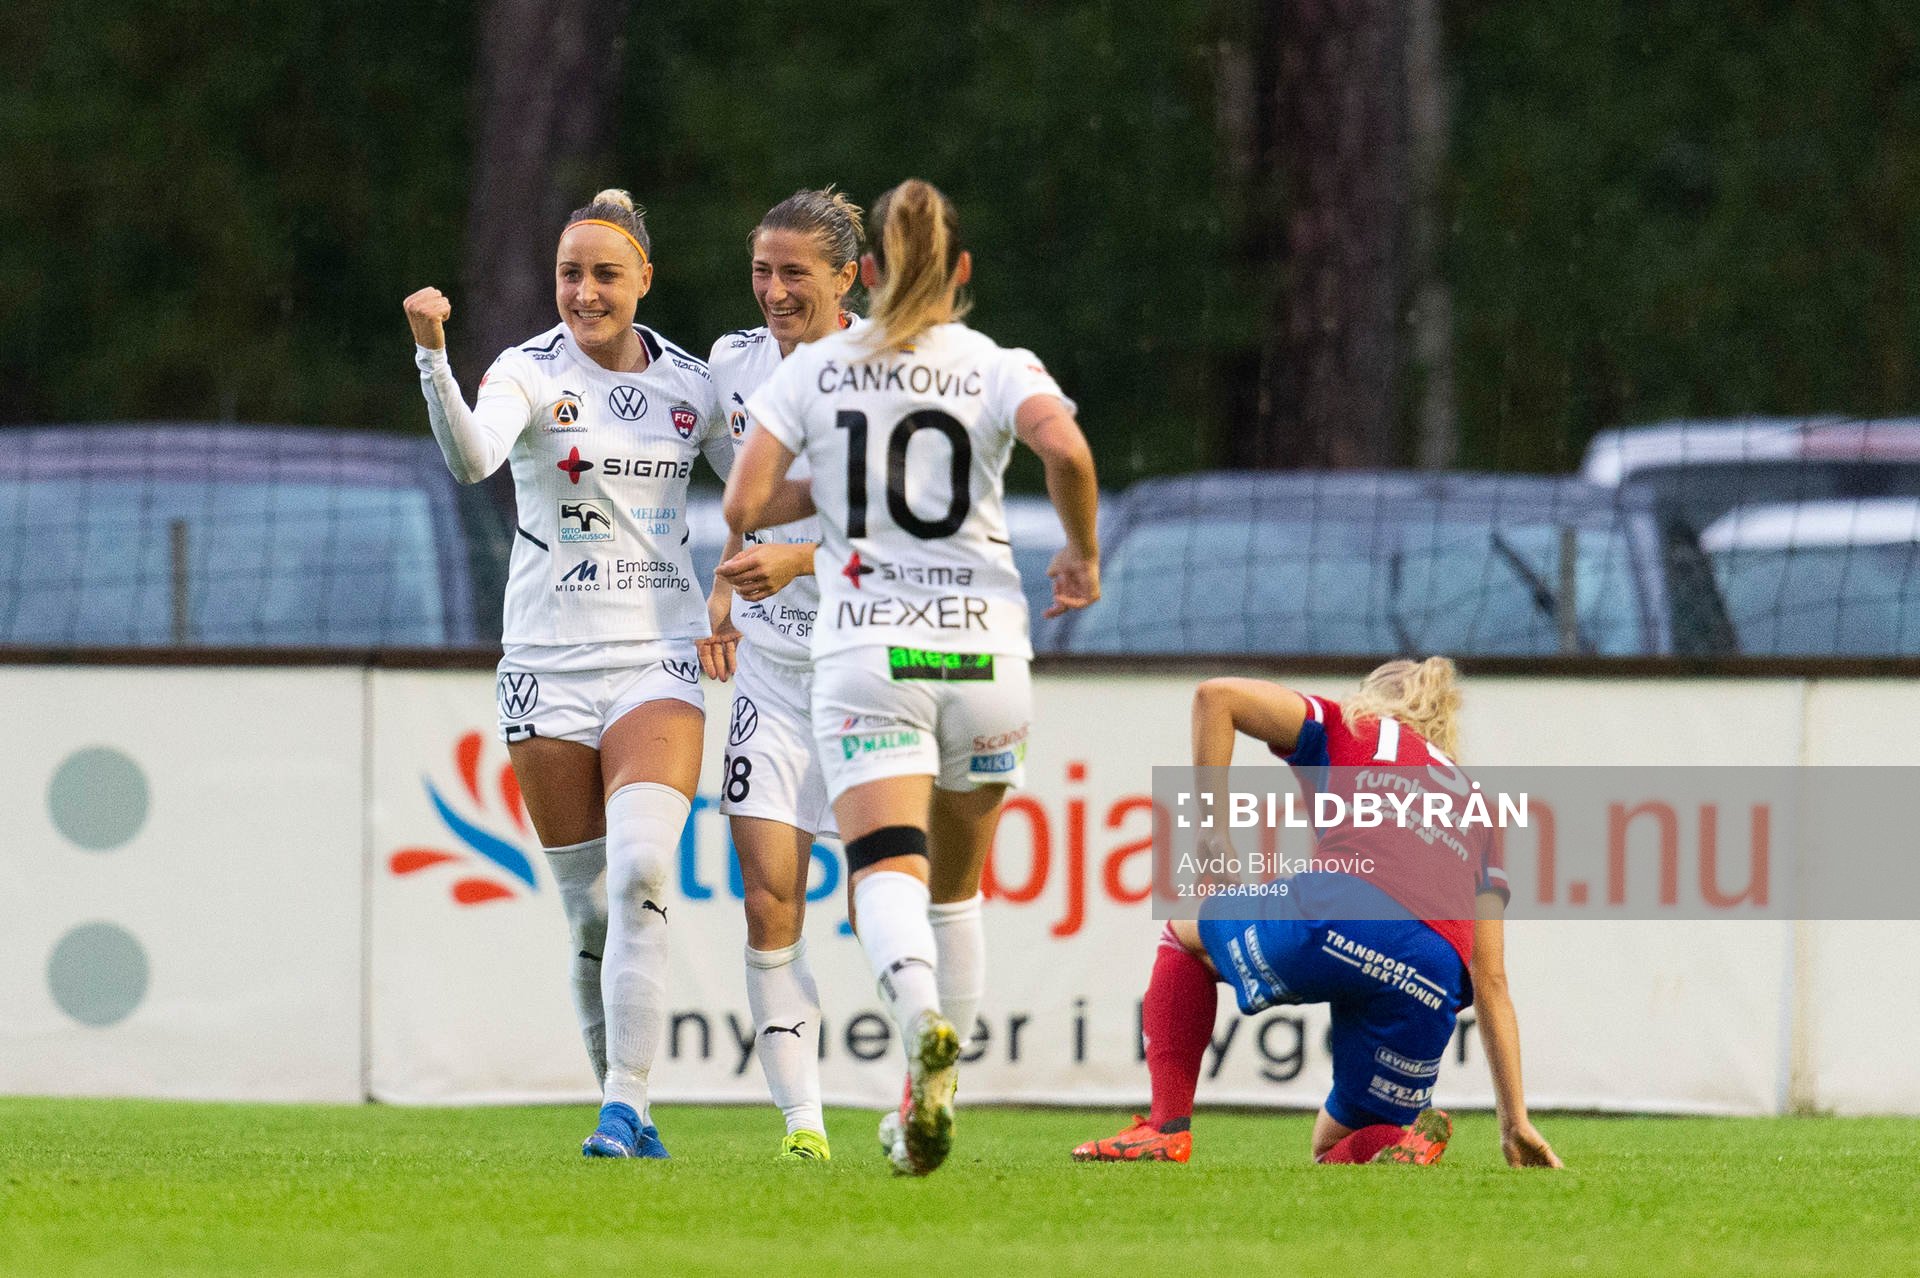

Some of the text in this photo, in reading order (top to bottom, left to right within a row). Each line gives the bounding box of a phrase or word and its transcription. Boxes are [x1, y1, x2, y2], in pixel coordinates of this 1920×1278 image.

[674, 413, 695, 424] FCR
[835, 409, 972, 540] 10
[560, 533, 610, 541] MAGNUSSON
[555, 583, 600, 592] MIDROC
[616, 574, 690, 592] of Sharing
[1361, 961, 1444, 1011] SEKTIONEN
[1071, 998, 1086, 1065] i
